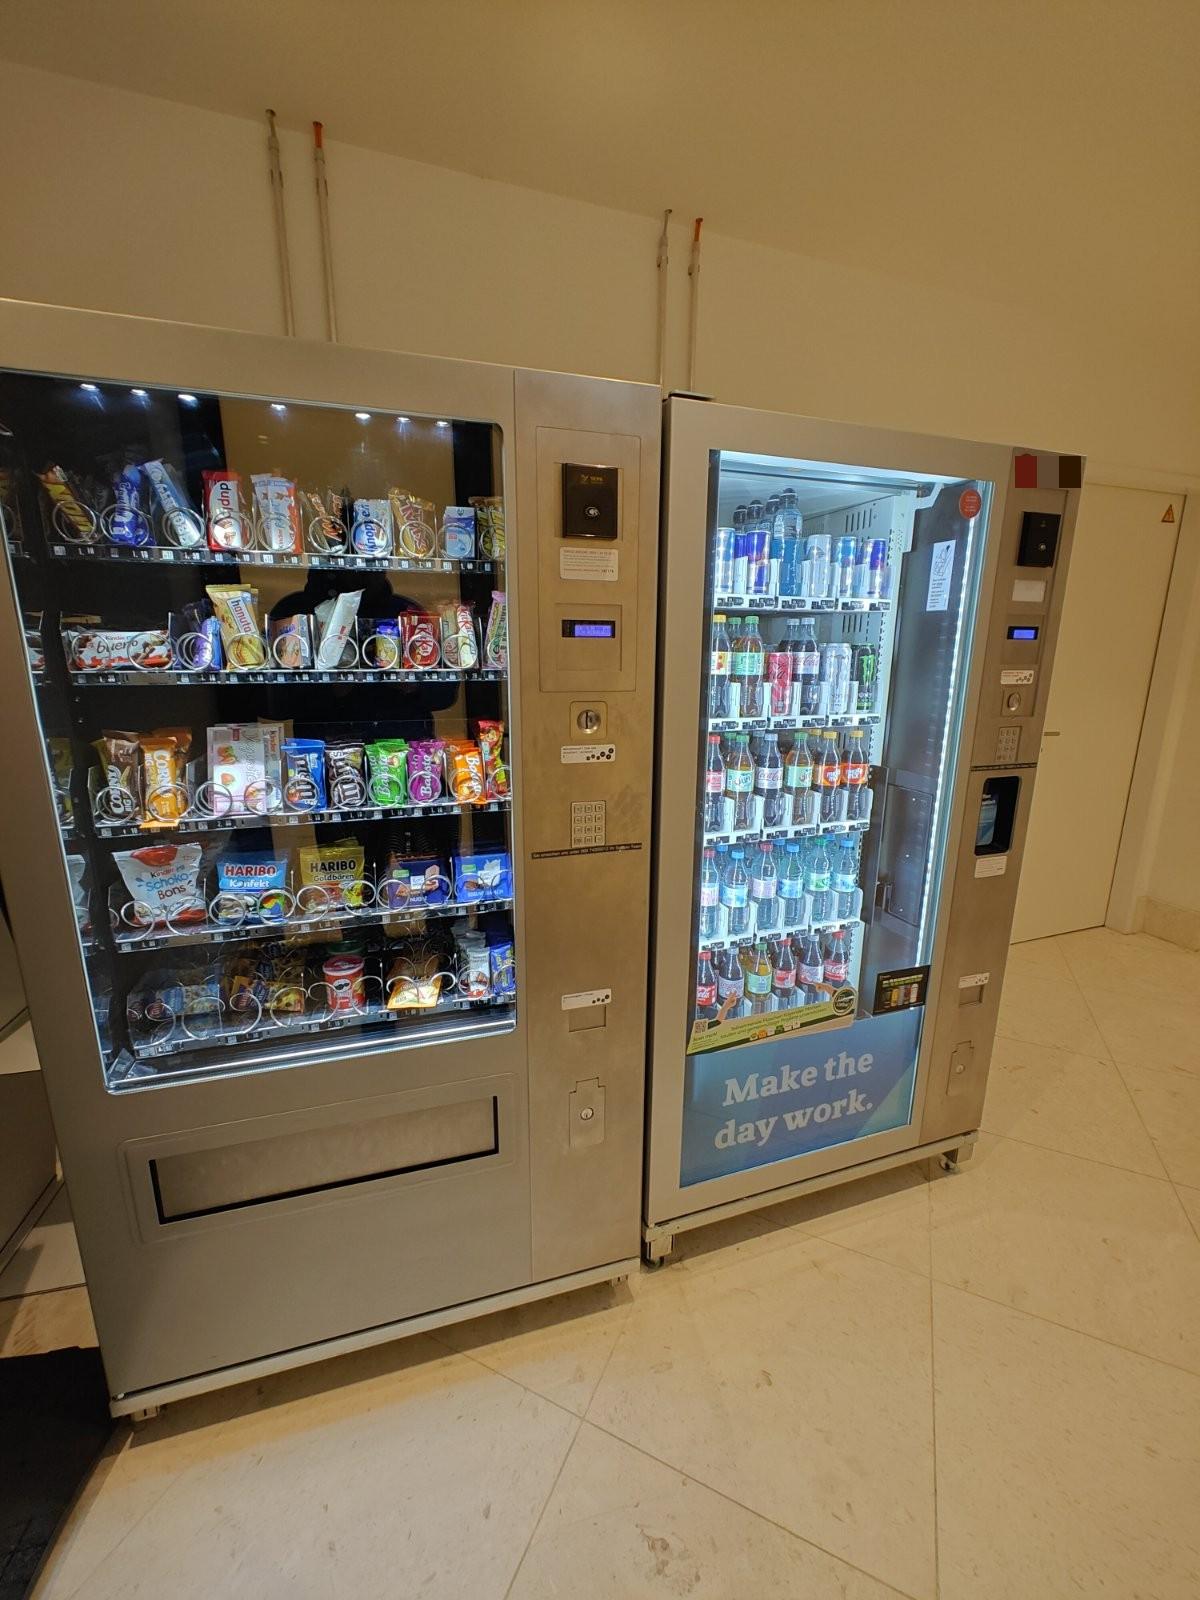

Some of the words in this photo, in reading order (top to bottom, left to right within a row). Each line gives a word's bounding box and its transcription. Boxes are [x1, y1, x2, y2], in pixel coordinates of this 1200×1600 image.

[231, 599, 251, 633] hanuta
[96, 640, 139, 653] bueno
[420, 753, 432, 798] Balisto
[225, 864, 276, 877] HARIBO
[310, 859, 357, 873] HARIBO
[157, 884, 187, 900] Bons
[229, 879, 270, 889] Konfekt
[722, 1065, 818, 1107] Make
[824, 1051, 874, 1082] the
[714, 1116, 778, 1149] day
[783, 1089, 874, 1131] work.
